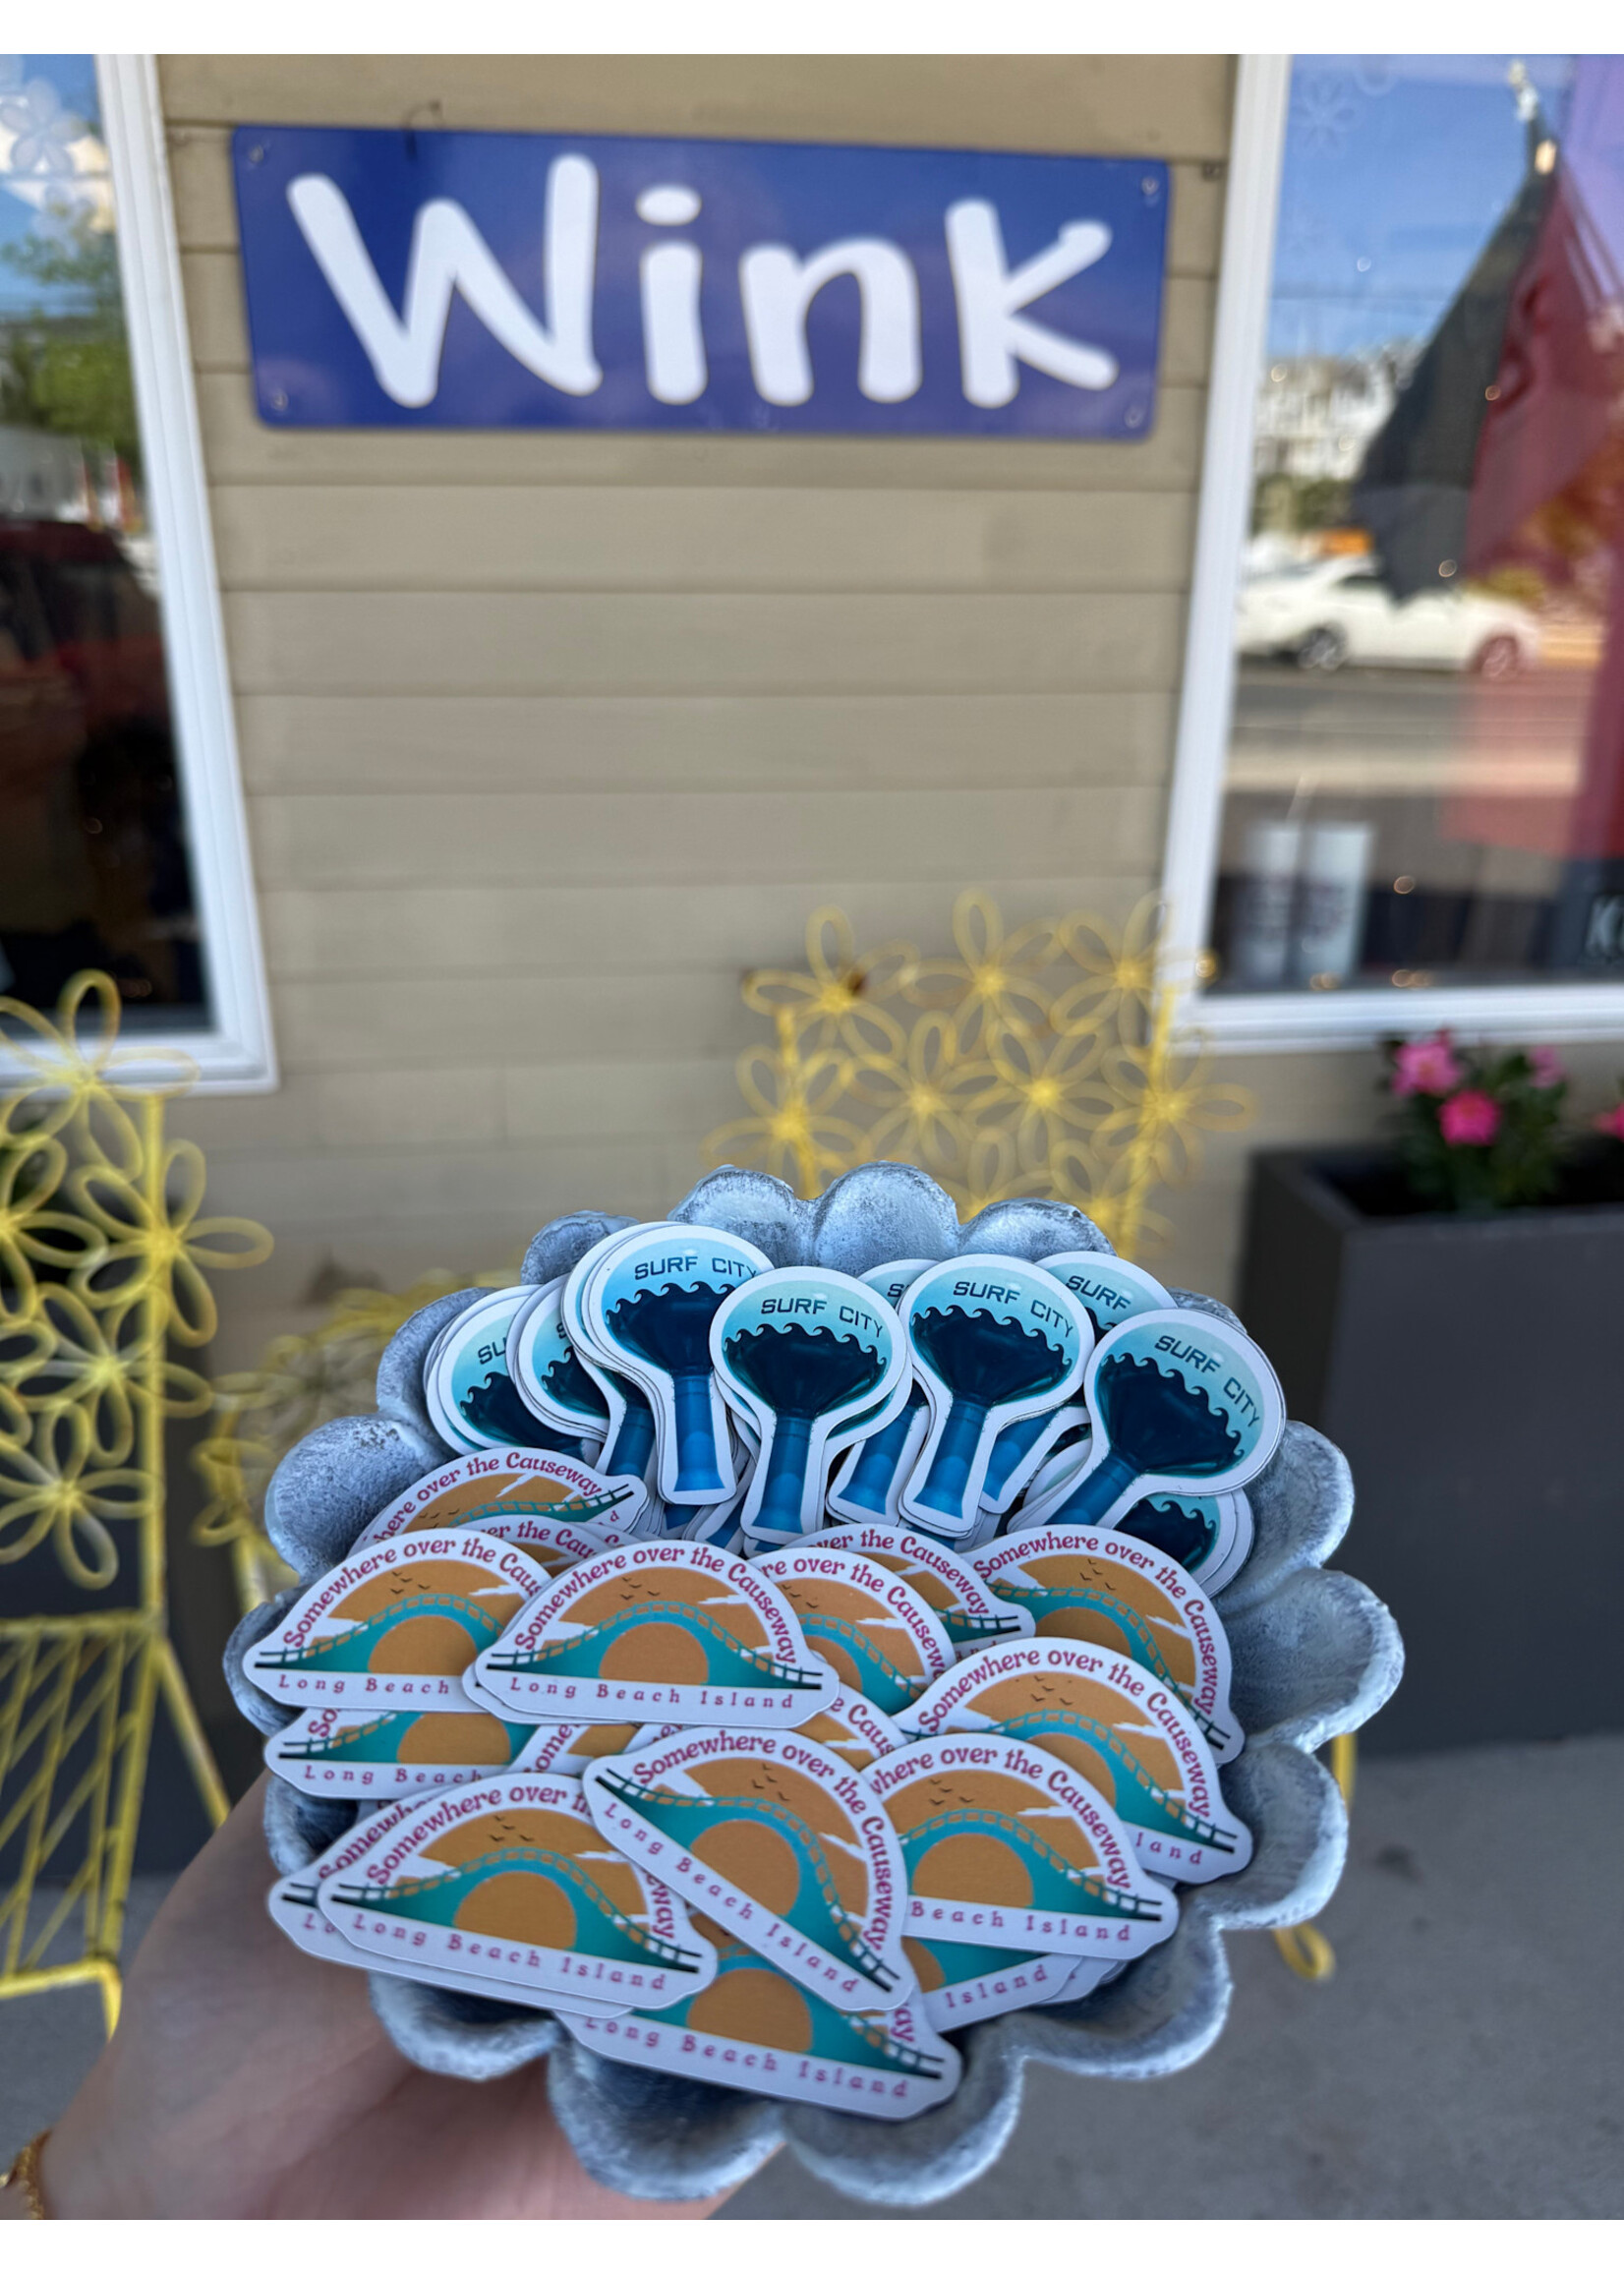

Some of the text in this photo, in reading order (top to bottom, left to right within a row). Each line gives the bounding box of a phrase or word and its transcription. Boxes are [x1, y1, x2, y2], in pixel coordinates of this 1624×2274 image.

[286, 153, 1119, 409] Wink
[634, 1255, 757, 1280] SURF CITY
[1066, 1275, 1131, 1312] SURF
[761, 1298, 883, 1338] SURF CITY
[953, 1280, 1073, 1338] SURF CITY
[478, 1337, 507, 1365] SU
[1154, 1334, 1260, 1428] SURF CITY
[416, 1452, 602, 1502] over the Causeway
[517, 1521, 551, 1540] the
[283, 1538, 542, 1648] Somewhere over the Caus
[810, 1529, 990, 1614] ver the Causeway
[515, 1546, 796, 1664] Somewhere over the Causeway
[793, 1557, 845, 1574] over
[849, 1563, 885, 1592] the
[887, 1586, 946, 1679] Causew
[973, 1532, 1218, 1716] Somewhere over the Causeway
[278, 1674, 449, 1694] Long Beach
[510, 1677, 794, 1709] Long Beach Island
[918, 1648, 1211, 1819] Somewhere over the Causeway
[304, 1766, 482, 1790] Long Beach
[367, 1786, 502, 1885] Somewhere
[509, 1785, 567, 1803] over
[633, 1730, 776, 1784] Somewhere
[782, 1741, 835, 1779] over
[834, 1777, 867, 1816] the
[861, 1816, 893, 1952] Causeway
[941, 1747, 998, 1765] over
[1004, 1750, 1043, 1778] the
[1047, 1771, 1131, 1890] Causeway
[1135, 1831, 1203, 1865] land
[604, 1803, 858, 1994] Long Beach Island
[911, 1901, 1131, 1941] Beach Island
[353, 1914, 667, 1990] Long Beach Island
[946, 1964, 1047, 2009] Island
[681, 2034, 778, 2072] Beach
[798, 2060, 908, 2098] Island
